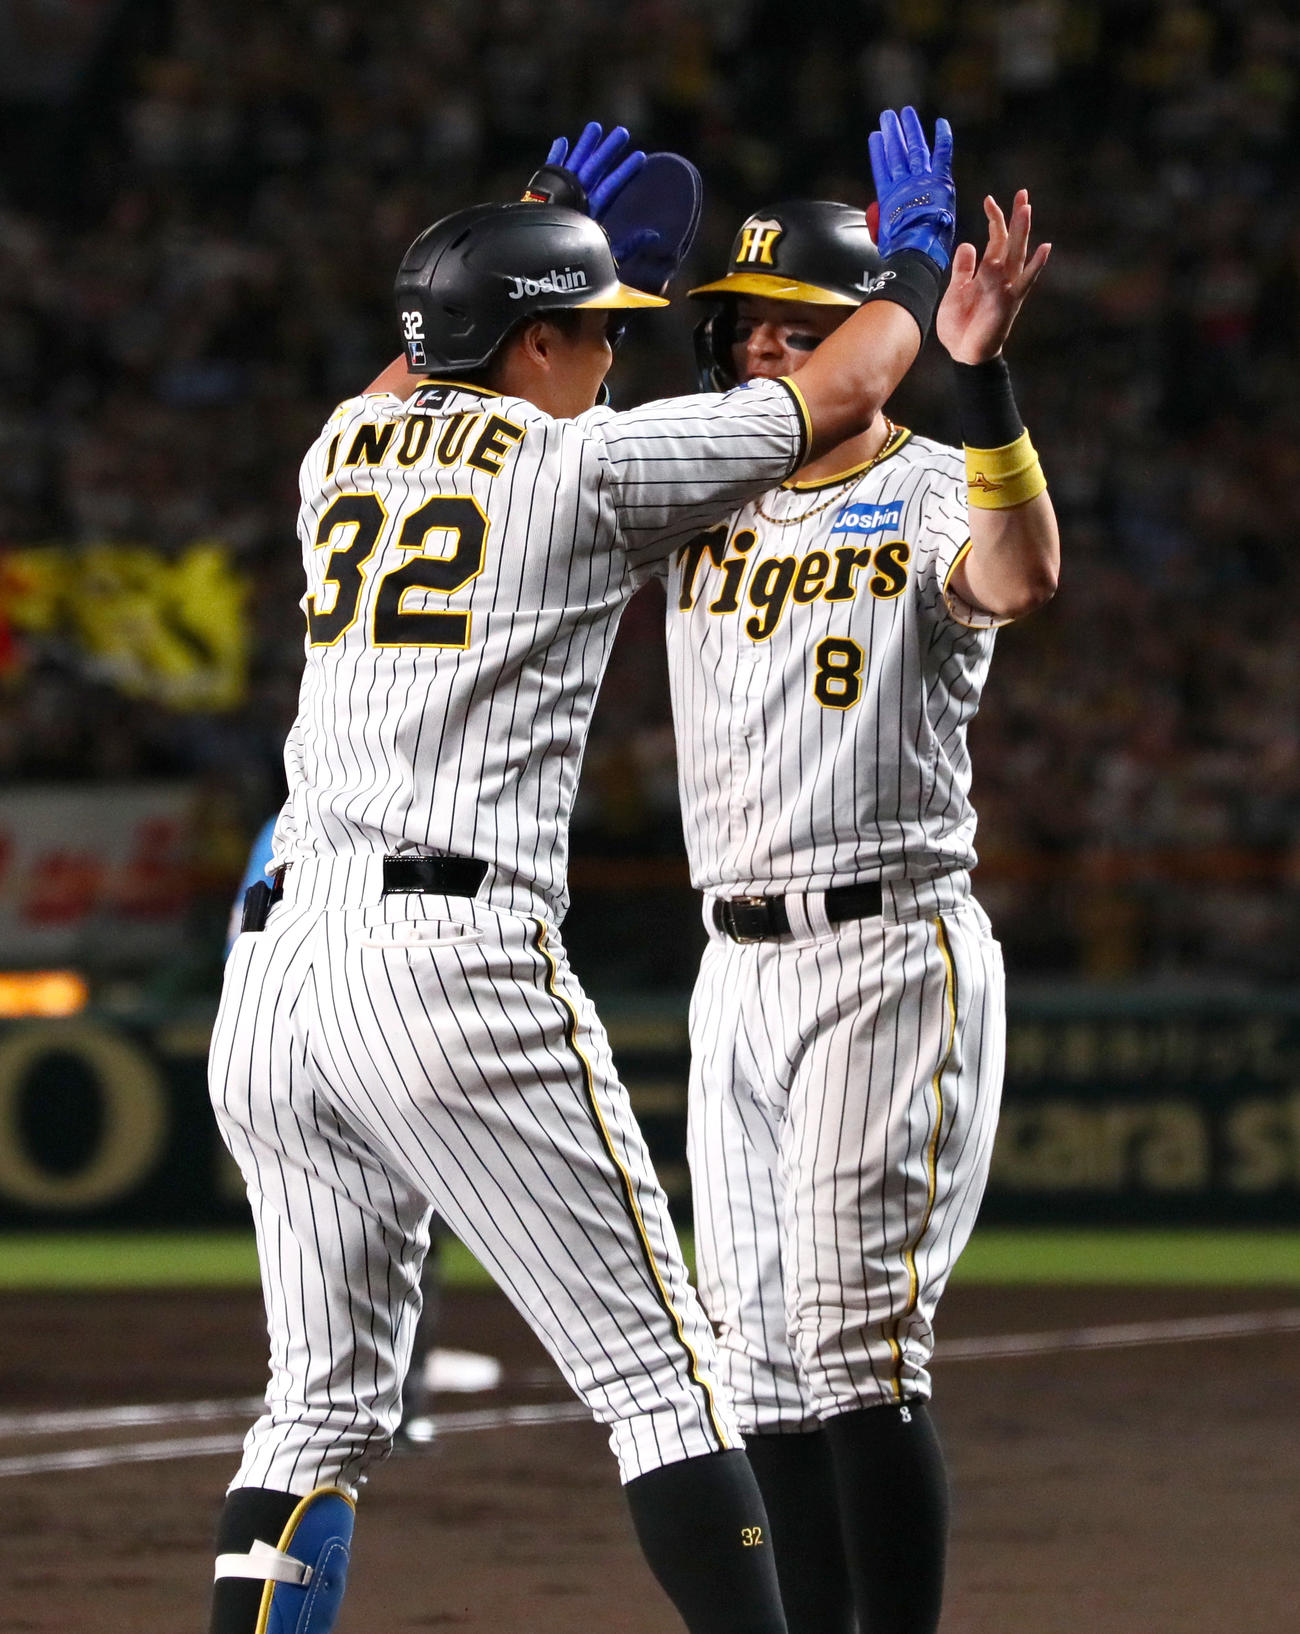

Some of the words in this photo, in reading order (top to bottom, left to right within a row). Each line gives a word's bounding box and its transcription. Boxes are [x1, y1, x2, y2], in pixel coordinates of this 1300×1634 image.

[508, 266, 588, 300] Joshin
[401, 311, 426, 340] 32
[324, 411, 528, 481] INOUE
[834, 508, 899, 530] Joshin
[306, 491, 491, 650] 32
[676, 524, 911, 643] Tigers
[812, 635, 866, 712] 8
[900, 1405, 912, 1424] 8
[740, 1526, 764, 1547] 32
